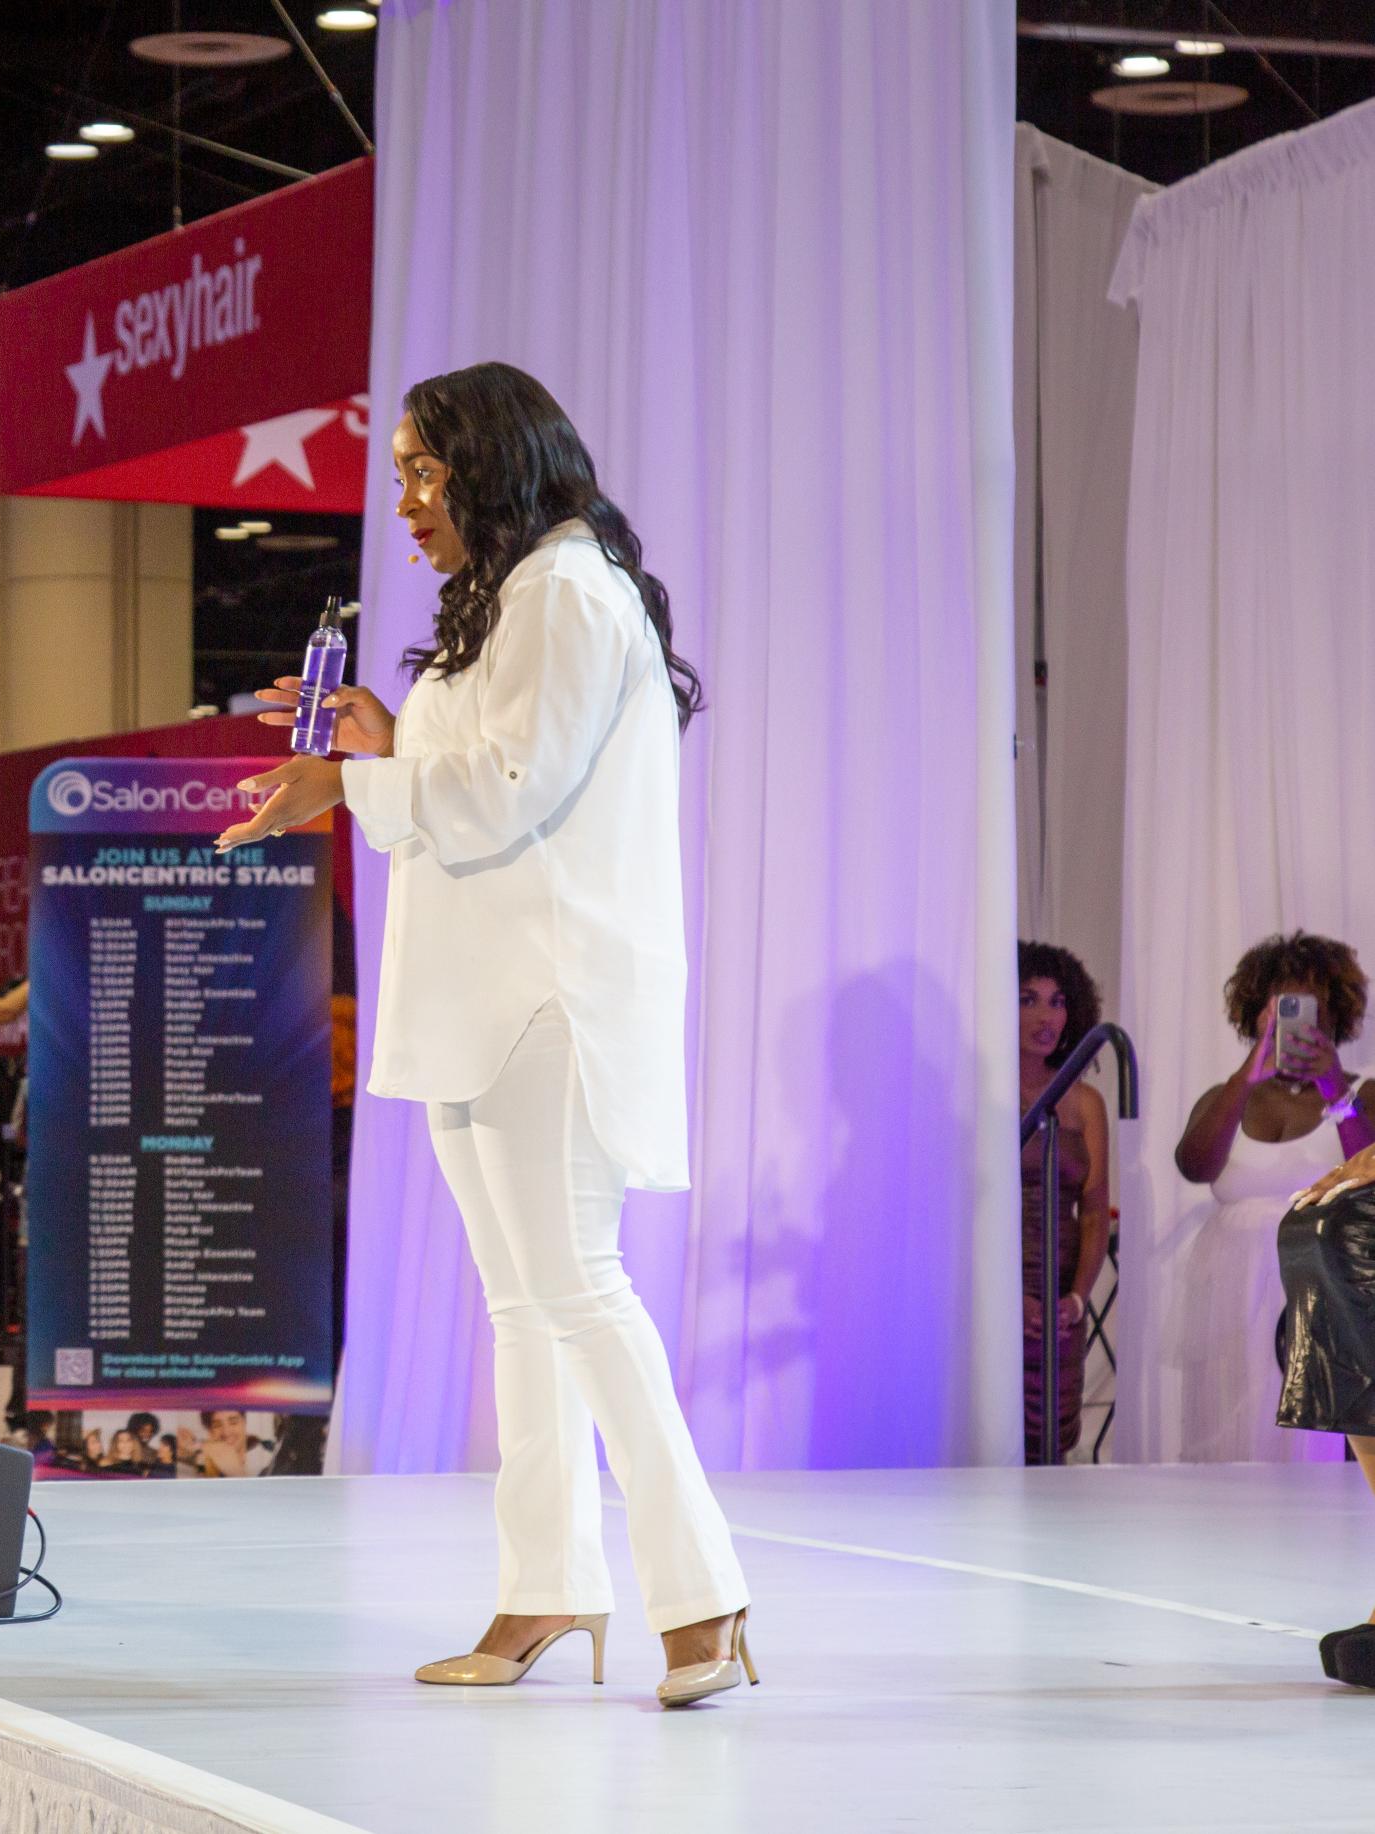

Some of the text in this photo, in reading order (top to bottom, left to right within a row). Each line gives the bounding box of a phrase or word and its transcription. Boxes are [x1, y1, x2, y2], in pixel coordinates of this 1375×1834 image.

[95, 848, 265, 865] JOIN US AT THE
[42, 866, 315, 886] SALONCENTRIC STAGE
[143, 896, 213, 911] SUNDAY
[141, 1136, 214, 1151] MONDAY
